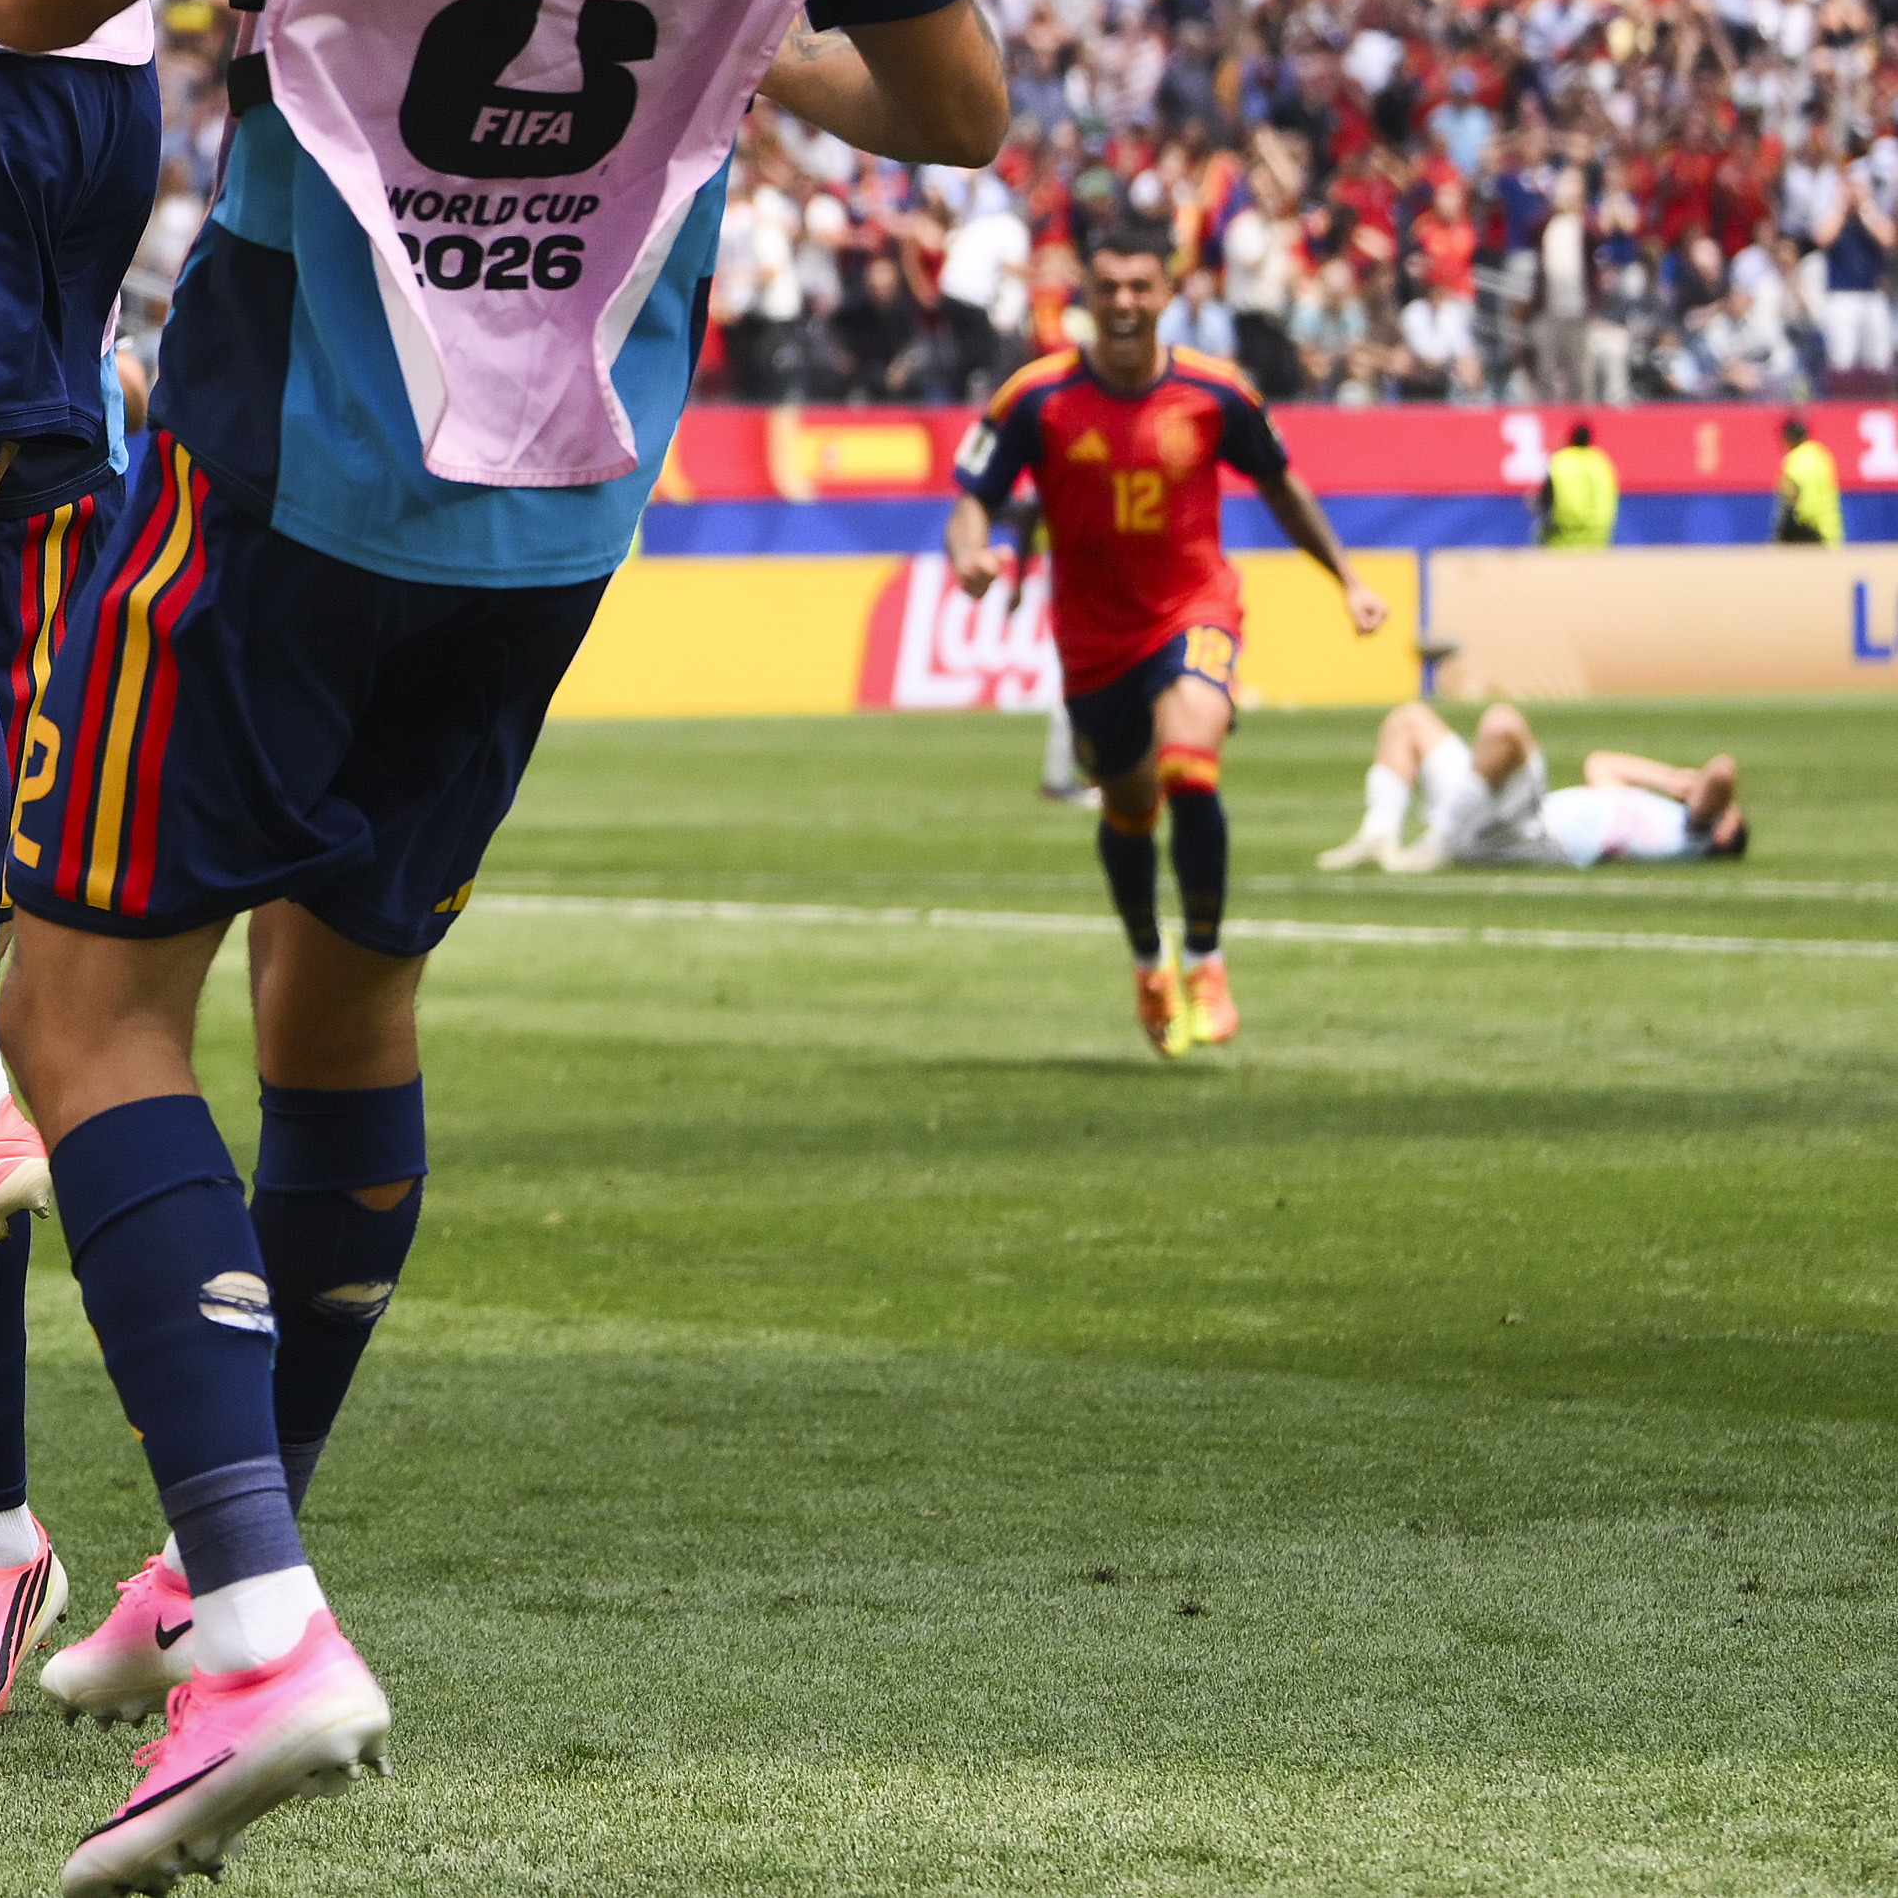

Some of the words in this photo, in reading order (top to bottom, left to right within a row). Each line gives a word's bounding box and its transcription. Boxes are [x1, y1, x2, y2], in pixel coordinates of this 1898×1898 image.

[470, 105, 574, 146] FIFA
[385, 185, 518, 226] WORLD
[524, 194, 600, 224] CUP
[1114, 470, 1166, 534] 12
[893, 552, 1064, 713] Lay
[1184, 625, 1234, 682] 12
